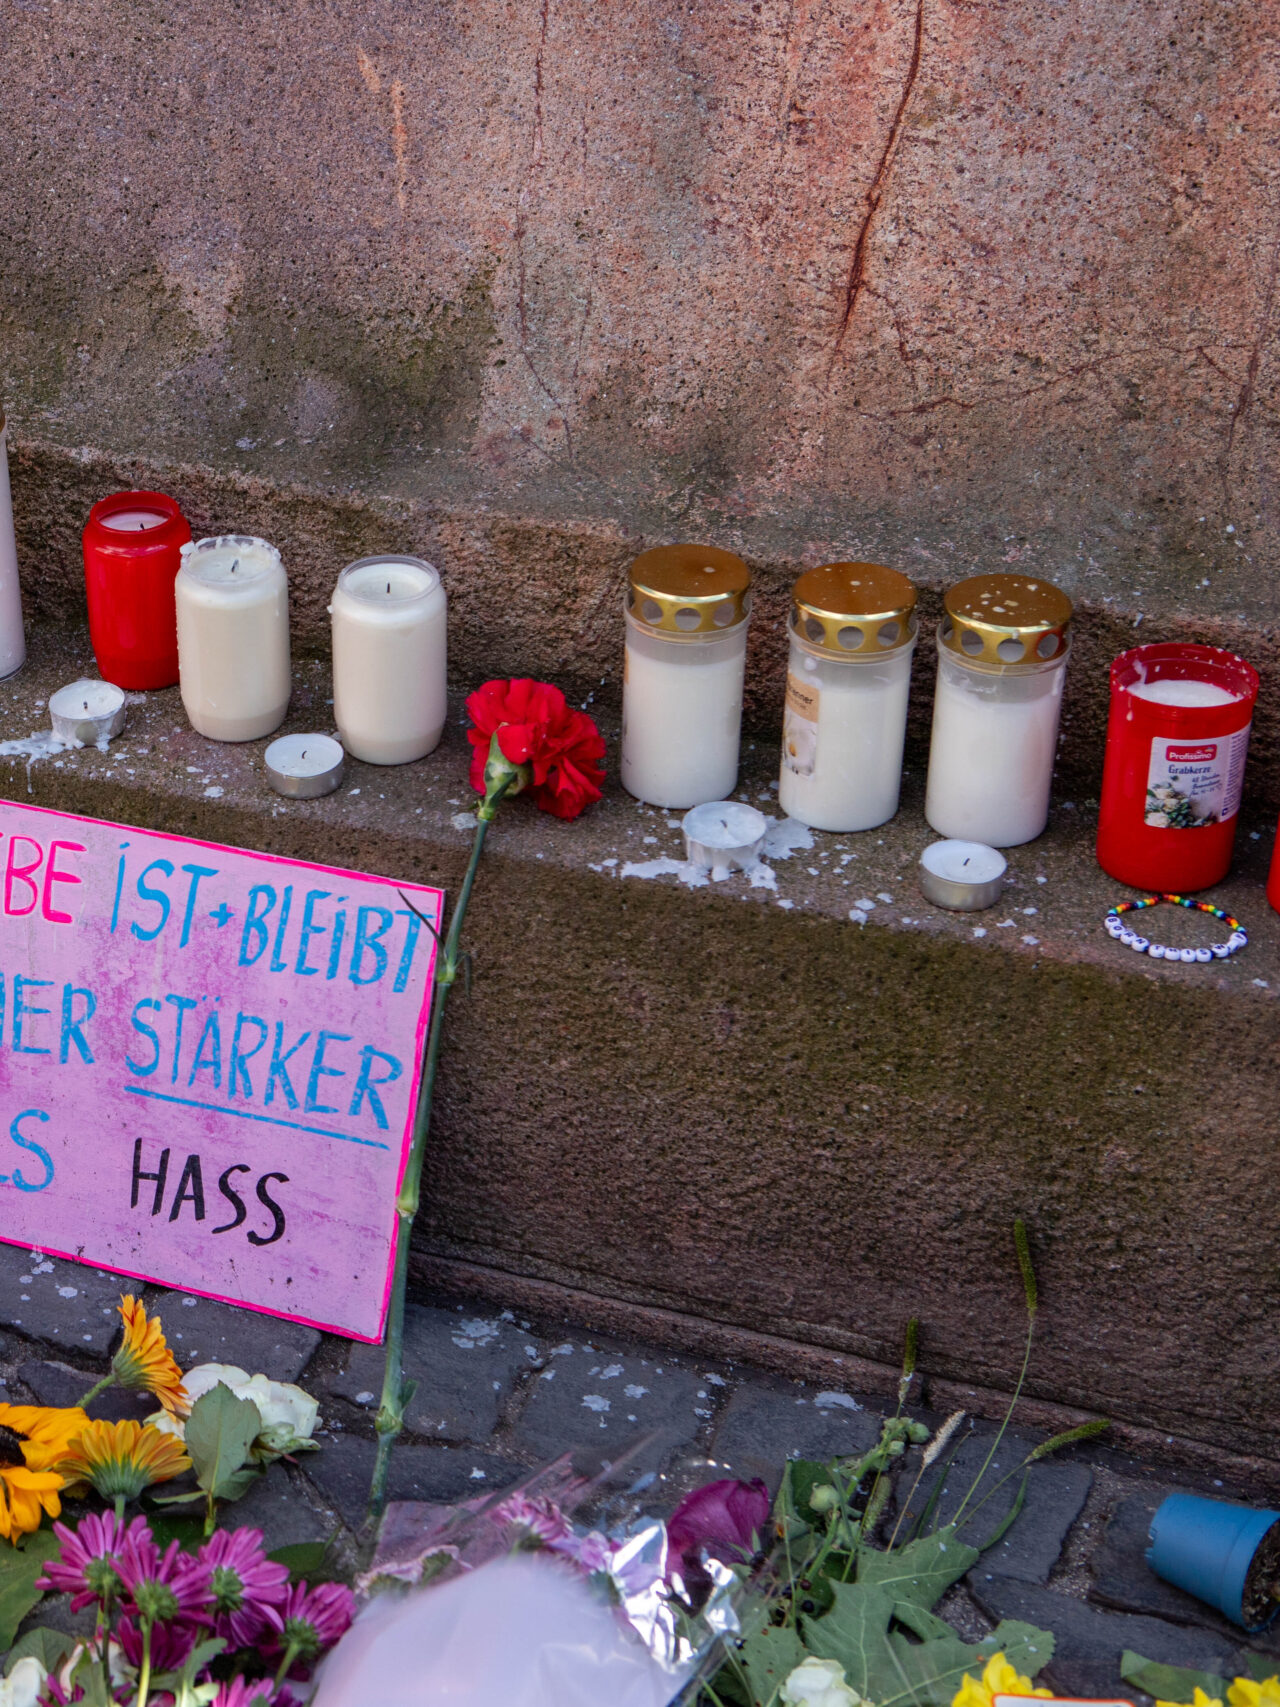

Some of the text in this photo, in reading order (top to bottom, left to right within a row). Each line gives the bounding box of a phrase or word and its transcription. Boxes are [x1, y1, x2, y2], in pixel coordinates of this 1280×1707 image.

[1168, 764, 1211, 775] Grabkerze
[1169, 751, 1212, 760] Profissimo
[1106, 917, 1246, 958] BORN THIS WY
[124, 993, 404, 1131] STÄRKER
[130, 1137, 291, 1247] HASS
